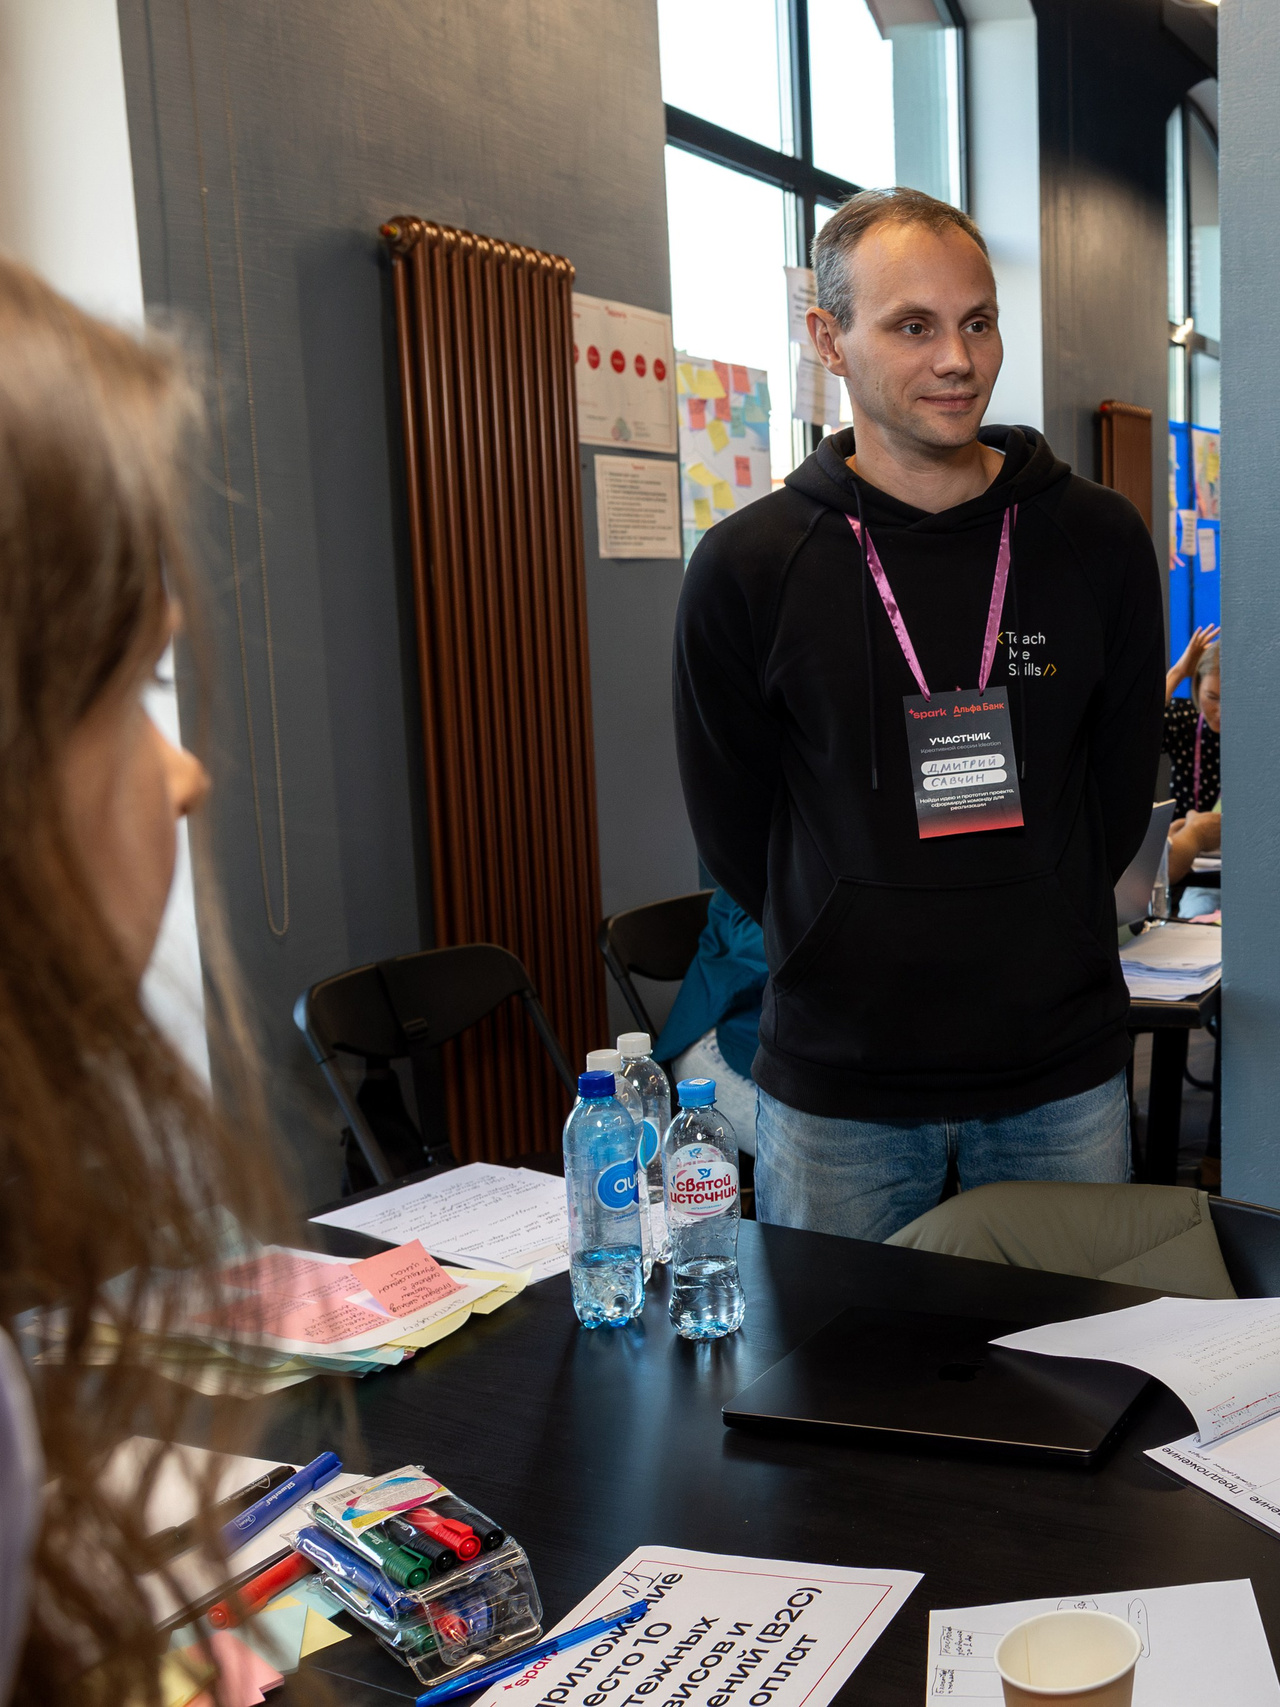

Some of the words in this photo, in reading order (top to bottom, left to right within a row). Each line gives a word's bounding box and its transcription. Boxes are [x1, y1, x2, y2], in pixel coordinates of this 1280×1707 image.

[913, 707, 947, 719] spark
[953, 704, 982, 717] Альфа
[982, 702, 1005, 711] Банк
[929, 731, 991, 746] УЧАСТНИК
[927, 756, 996, 774] ДМИТРИЙ
[931, 774, 985, 788] САВЧИН
[1161, 1446, 1245, 1496] Предложение
[619, 1615, 720, 1707] тежных
[705, 1646, 768, 1707] ений
[755, 1585, 823, 1645] (B2C)
[582, 1651, 646, 1707] есто
[633, 1621, 673, 1654] 10
[662, 1640, 735, 1707] висов
[733, 1621, 754, 1637] и
